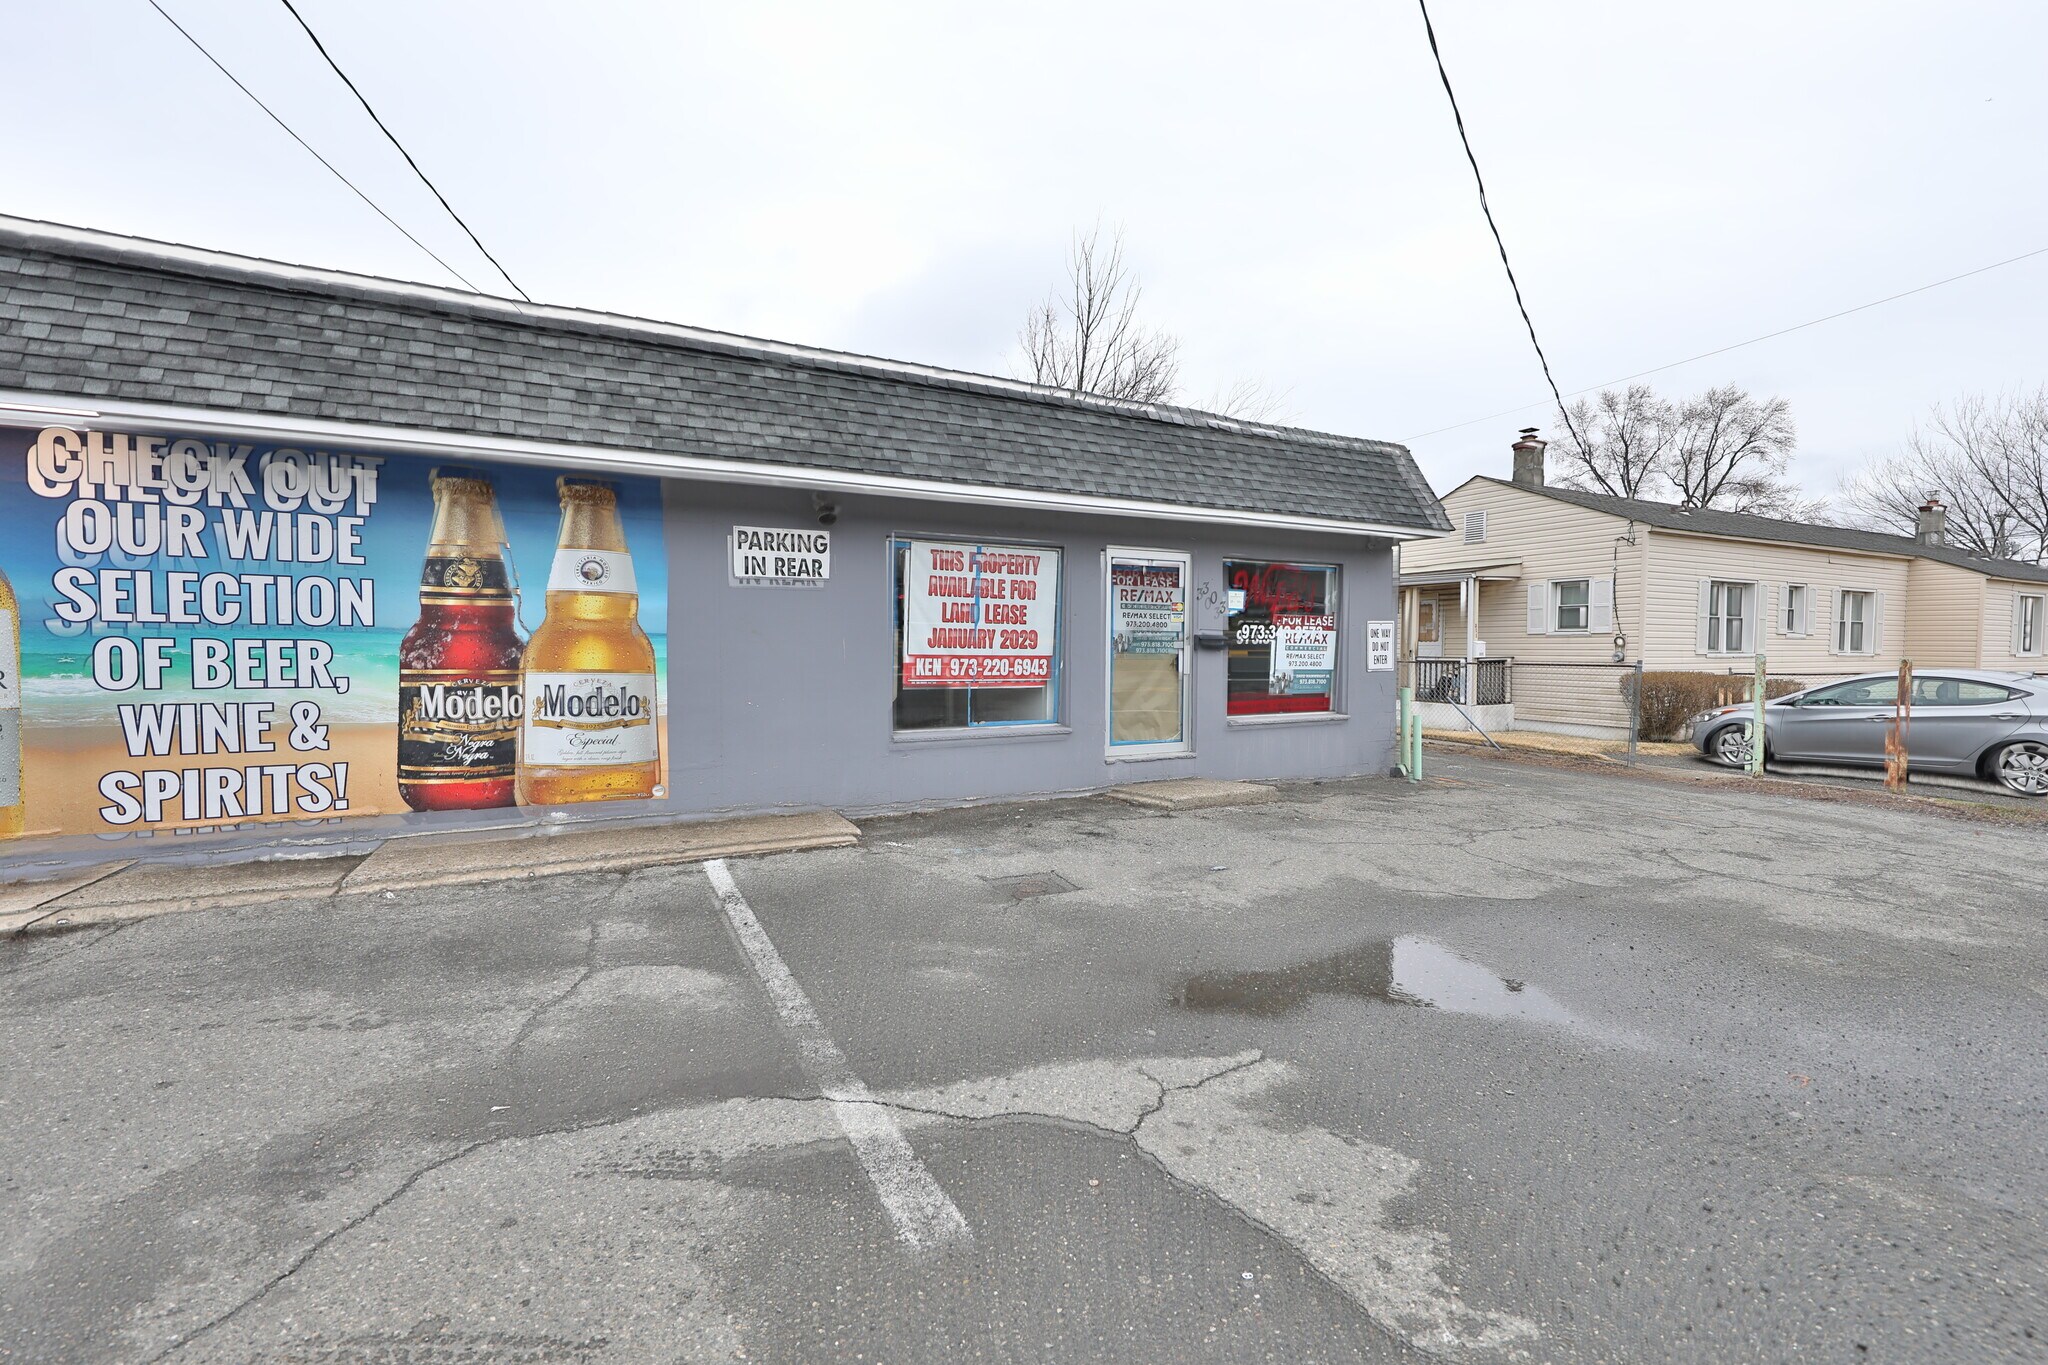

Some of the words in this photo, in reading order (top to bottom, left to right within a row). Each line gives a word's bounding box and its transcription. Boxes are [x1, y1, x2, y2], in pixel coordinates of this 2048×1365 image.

[34, 427, 257, 500] CHECK
[266, 449, 385, 508] OUT
[66, 498, 208, 558] OUR
[222, 508, 367, 565] WIDE
[737, 530, 828, 554] PARKING
[744, 556, 767, 575] IN
[774, 557, 823, 577] REAR
[930, 549, 964, 572] THIS
[968, 552, 1041, 576] PROPERTY
[52, 567, 374, 627] SELECTION
[928, 575, 1006, 600] AVAILABLE
[1010, 580, 1037, 601] FOR
[1120, 589, 1174, 603] RE/MAX
[984, 603, 1028, 625] LEASE
[1122, 612, 1147, 620] RE/MAX
[1125, 620, 1168, 628] 973.200.4800
[1283, 617, 1303, 626] FOR
[1304, 615, 1334, 627] LEASE
[927, 628, 996, 649] JANUARY
[1000, 629, 1038, 649] 2029
[1370, 629, 1380, 638] ONE
[1381, 629, 1391, 638] WAY
[1372, 642, 1379, 651] DO
[1380, 642, 1389, 651] NOT
[92, 636, 176, 691] OF
[191, 638, 350, 694] BEER,
[915, 658, 942, 676] KEN
[950, 658, 1048, 676] 973-220-6943
[1373, 655, 1388, 664] ENTER
[573, 678, 612, 687] CERVEZA
[420, 684, 524, 720] Modelo
[544, 684, 640, 717] Modelo
[118, 702, 276, 757] WINE
[289, 701, 330, 751] &
[566, 732, 619, 749] Especial
[99, 762, 350, 825] SPIRITS!
